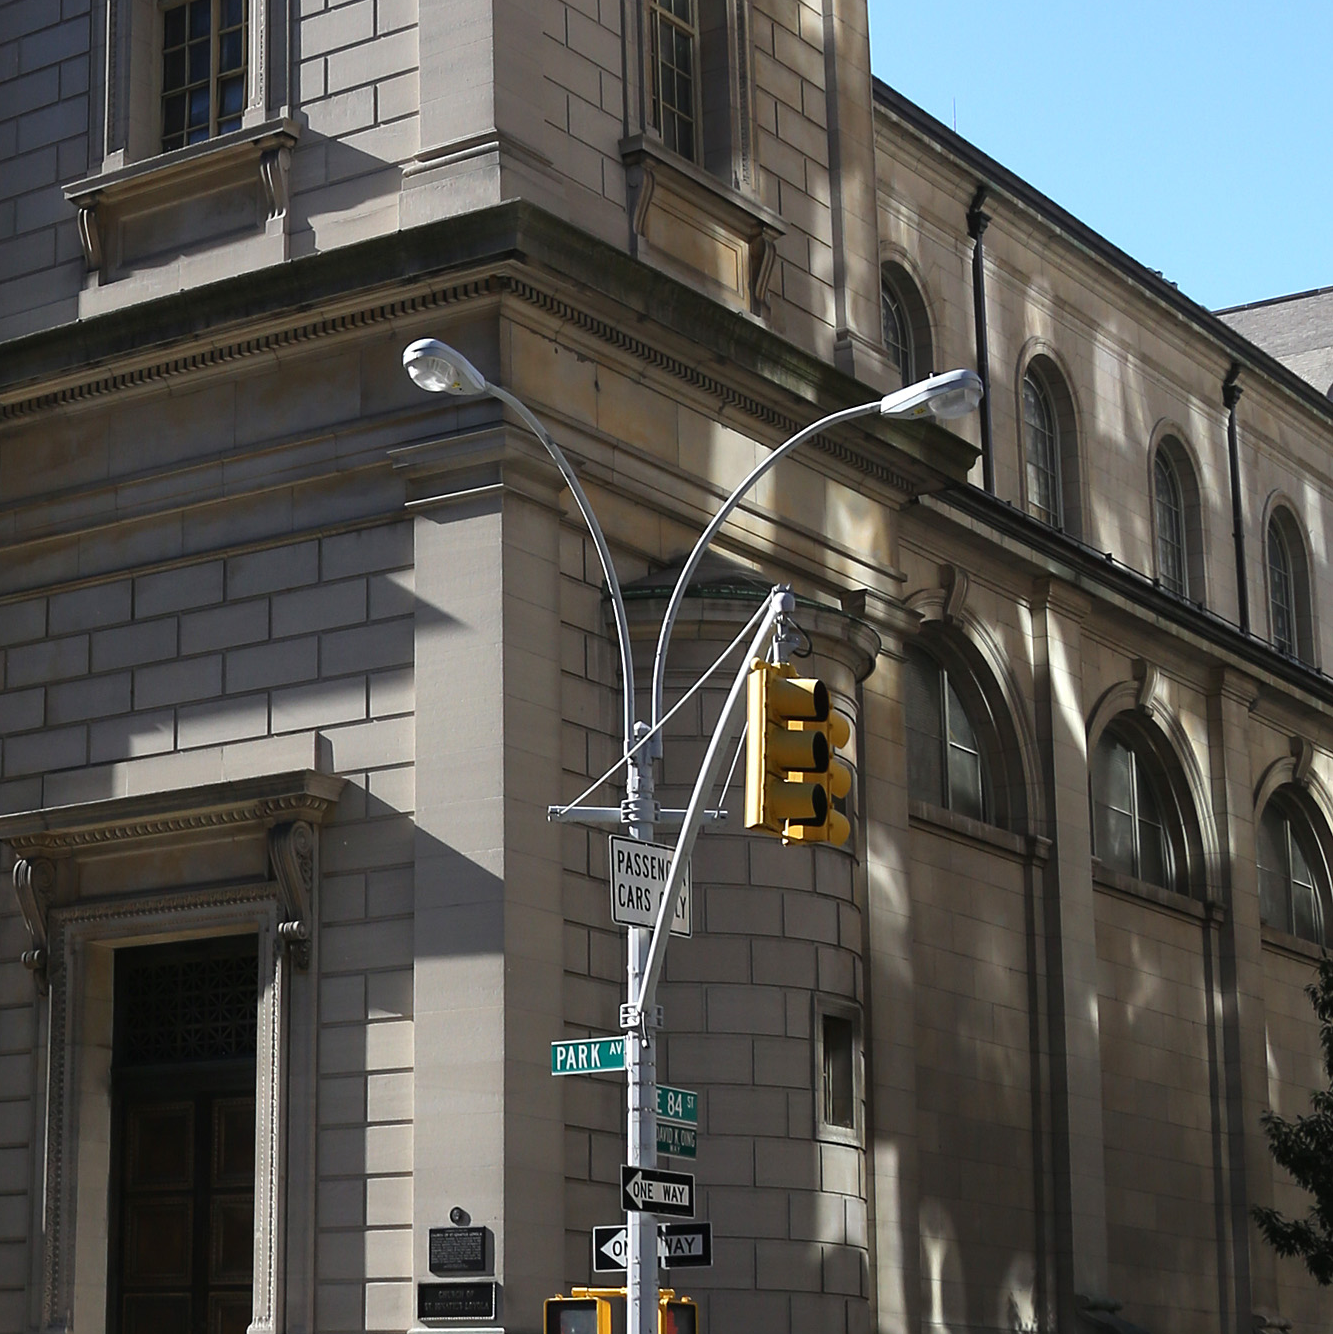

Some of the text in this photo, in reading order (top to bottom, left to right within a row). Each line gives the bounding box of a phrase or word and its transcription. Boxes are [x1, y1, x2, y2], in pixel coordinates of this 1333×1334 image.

[618, 883, 651, 912] CARS
[556, 1044, 601, 1070] PARK
[656, 1090, 694, 1117] E 84 ST
[633, 1181, 685, 1203] ONE WAY
